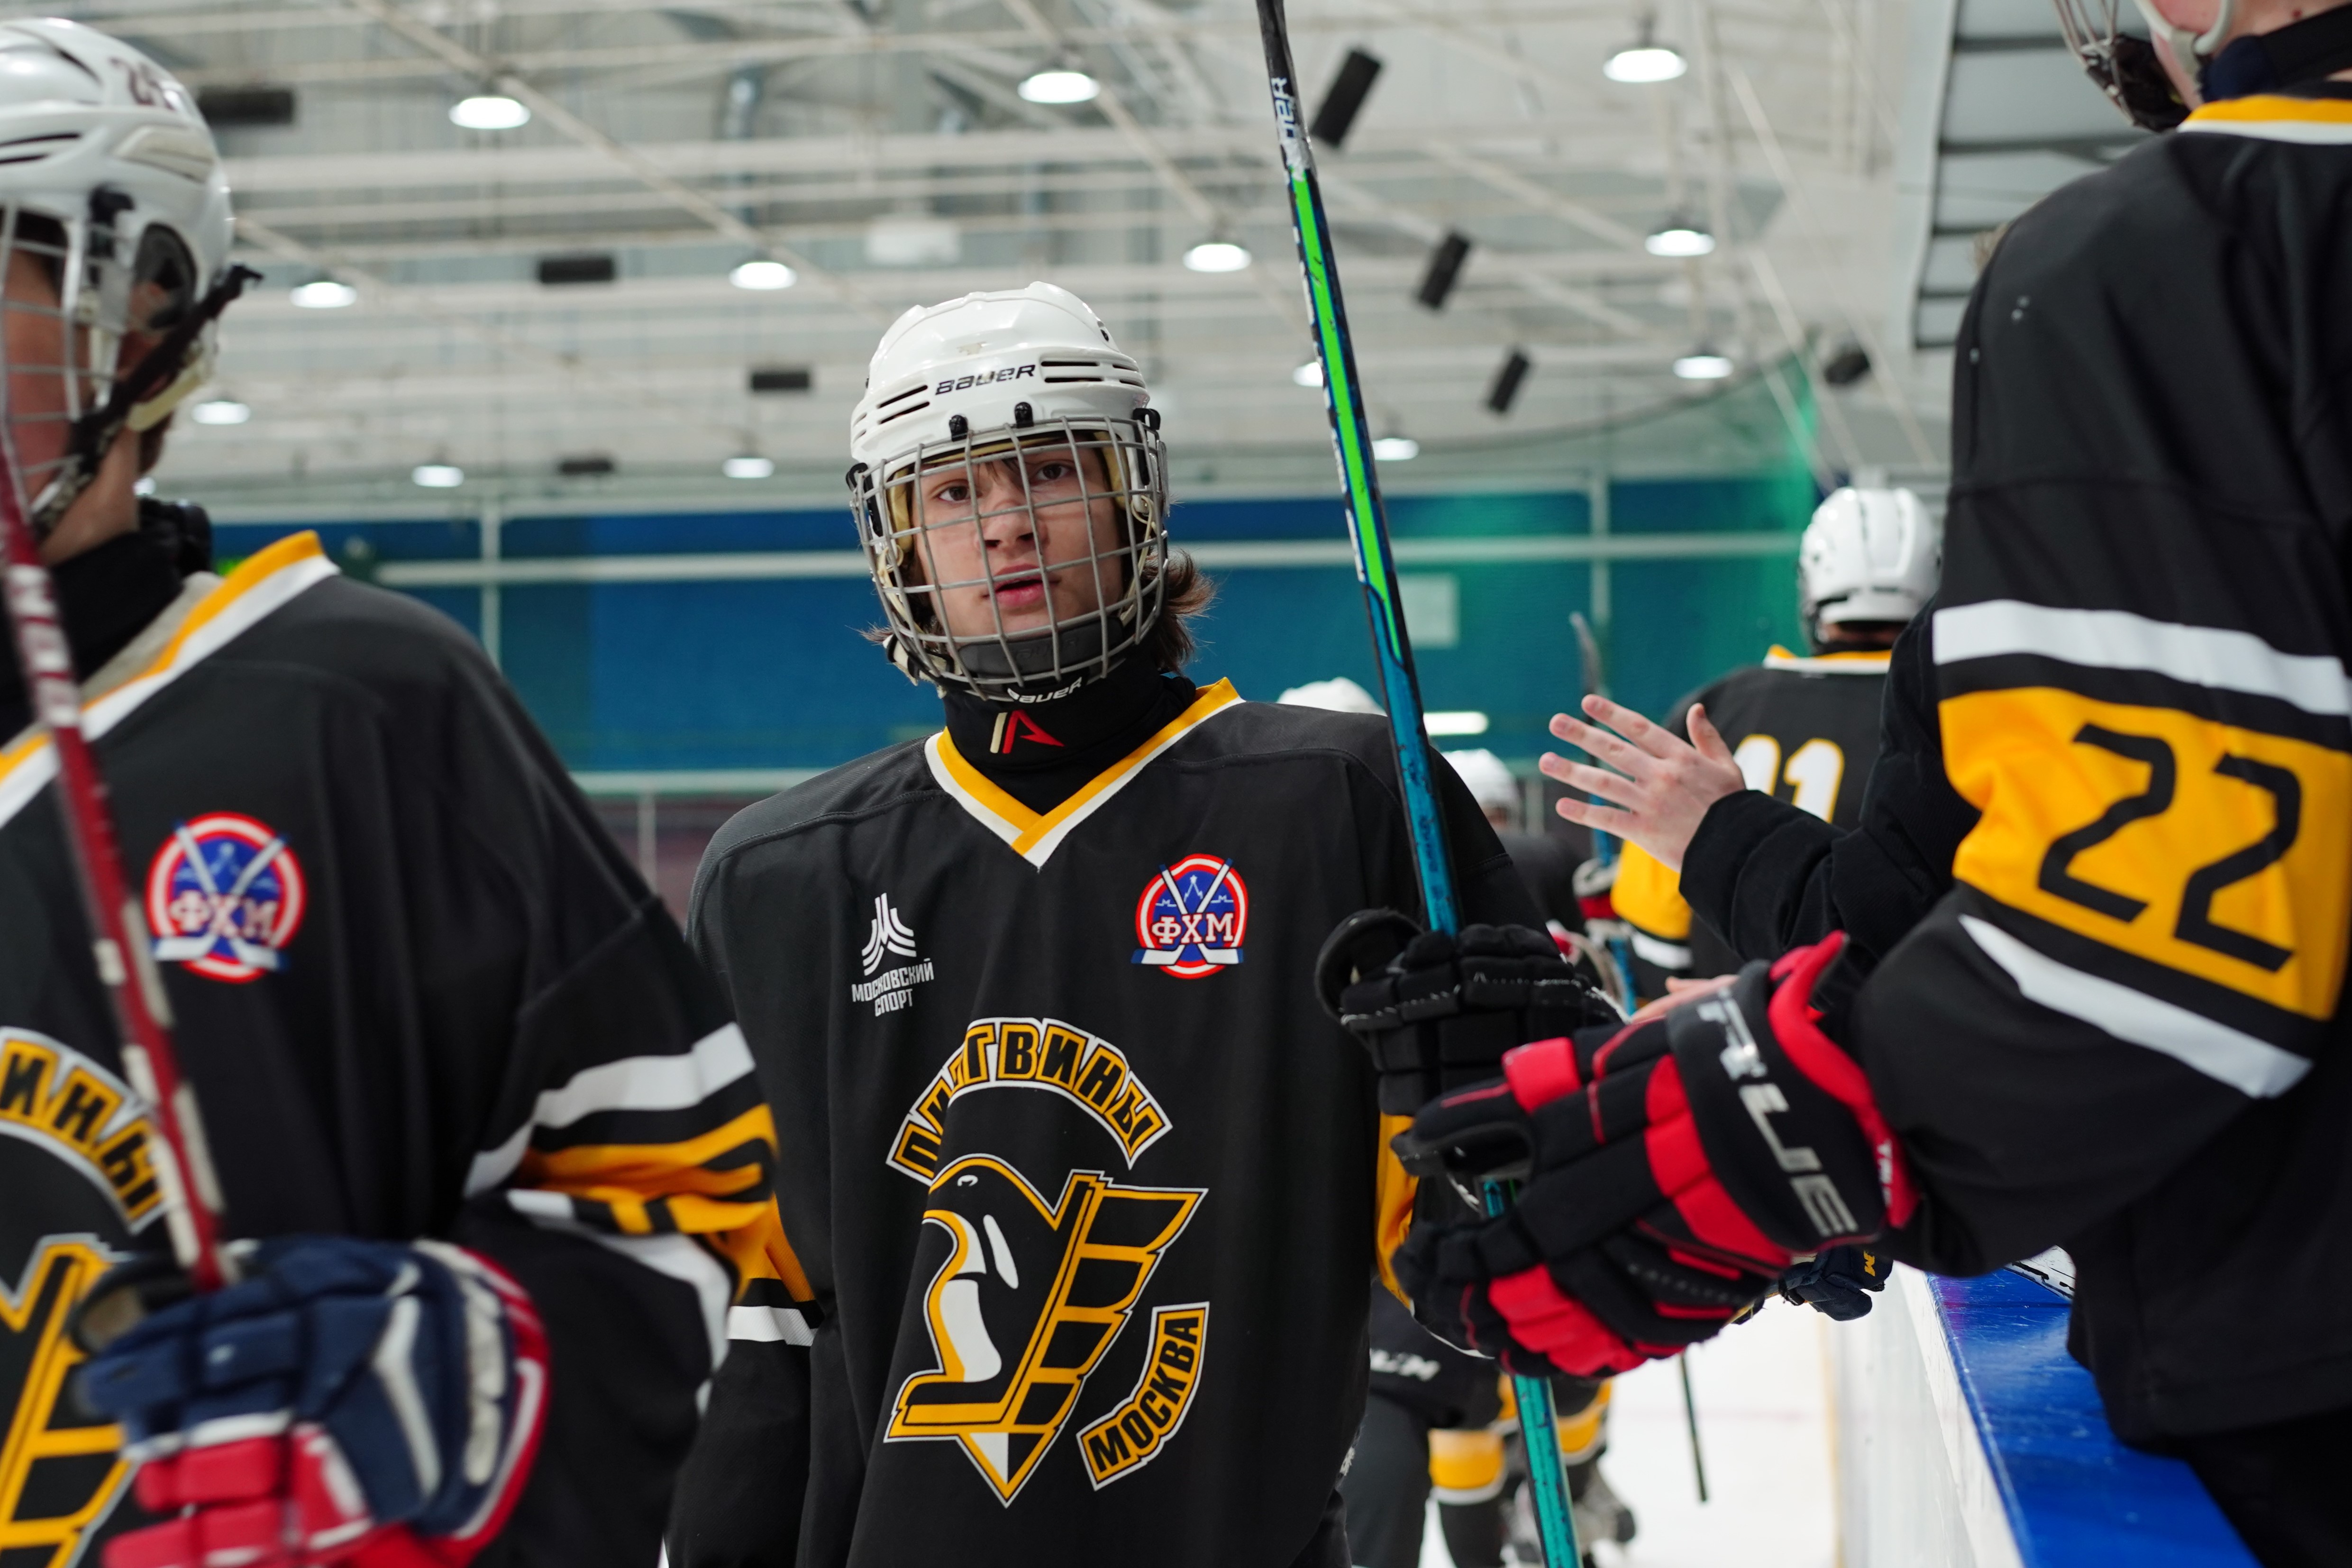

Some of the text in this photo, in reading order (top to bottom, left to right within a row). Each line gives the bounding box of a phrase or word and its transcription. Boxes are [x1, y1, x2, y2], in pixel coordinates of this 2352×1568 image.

[935, 364, 1036, 395] BAUER
[2039, 722, 2303, 973] 22
[169, 889, 278, 939] ФХМ
[1151, 912, 1234, 944] ФХМ
[851, 957, 935, 1003] МОСКОВСКИЙ
[874, 988, 913, 1017] СПОРТ
[1087, 1316, 1200, 1474] МОСКВА
